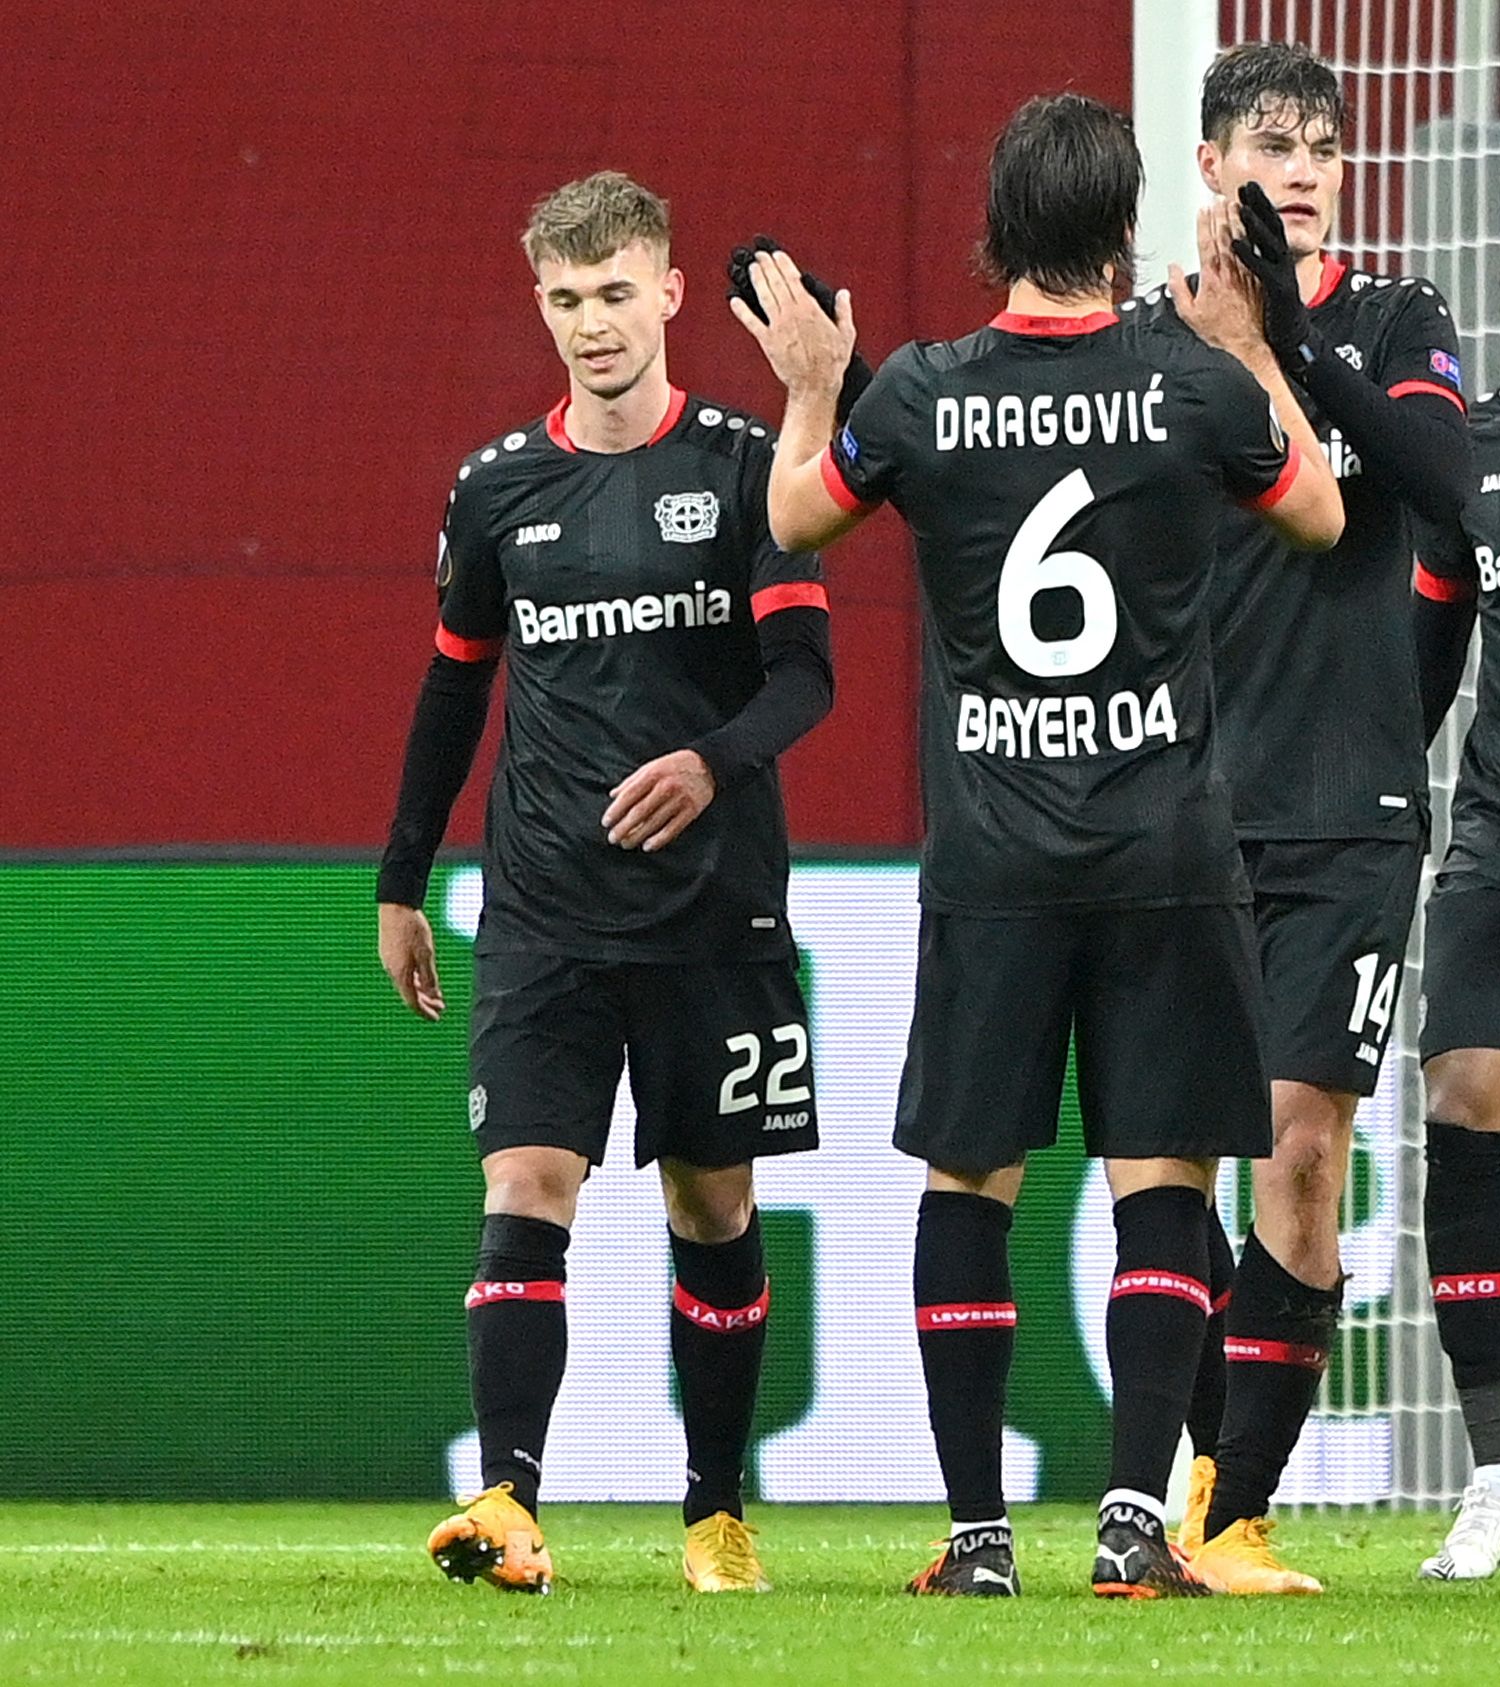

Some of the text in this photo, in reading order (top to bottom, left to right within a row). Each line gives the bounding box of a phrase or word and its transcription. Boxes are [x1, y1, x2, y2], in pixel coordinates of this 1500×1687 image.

[936, 373, 1168, 451] DRAGOVIĆ
[515, 522, 562, 546] JAKO
[997, 468, 1118, 678] 6
[513, 580, 732, 646] Barmenia
[956, 682, 1178, 759] BAYER 04
[1347, 952, 1398, 1044] 14
[718, 1023, 811, 1115] 22
[762, 1111, 810, 1131] JAKO
[464, 1282, 525, 1309] AKO
[686, 1305, 761, 1329] JAKO
